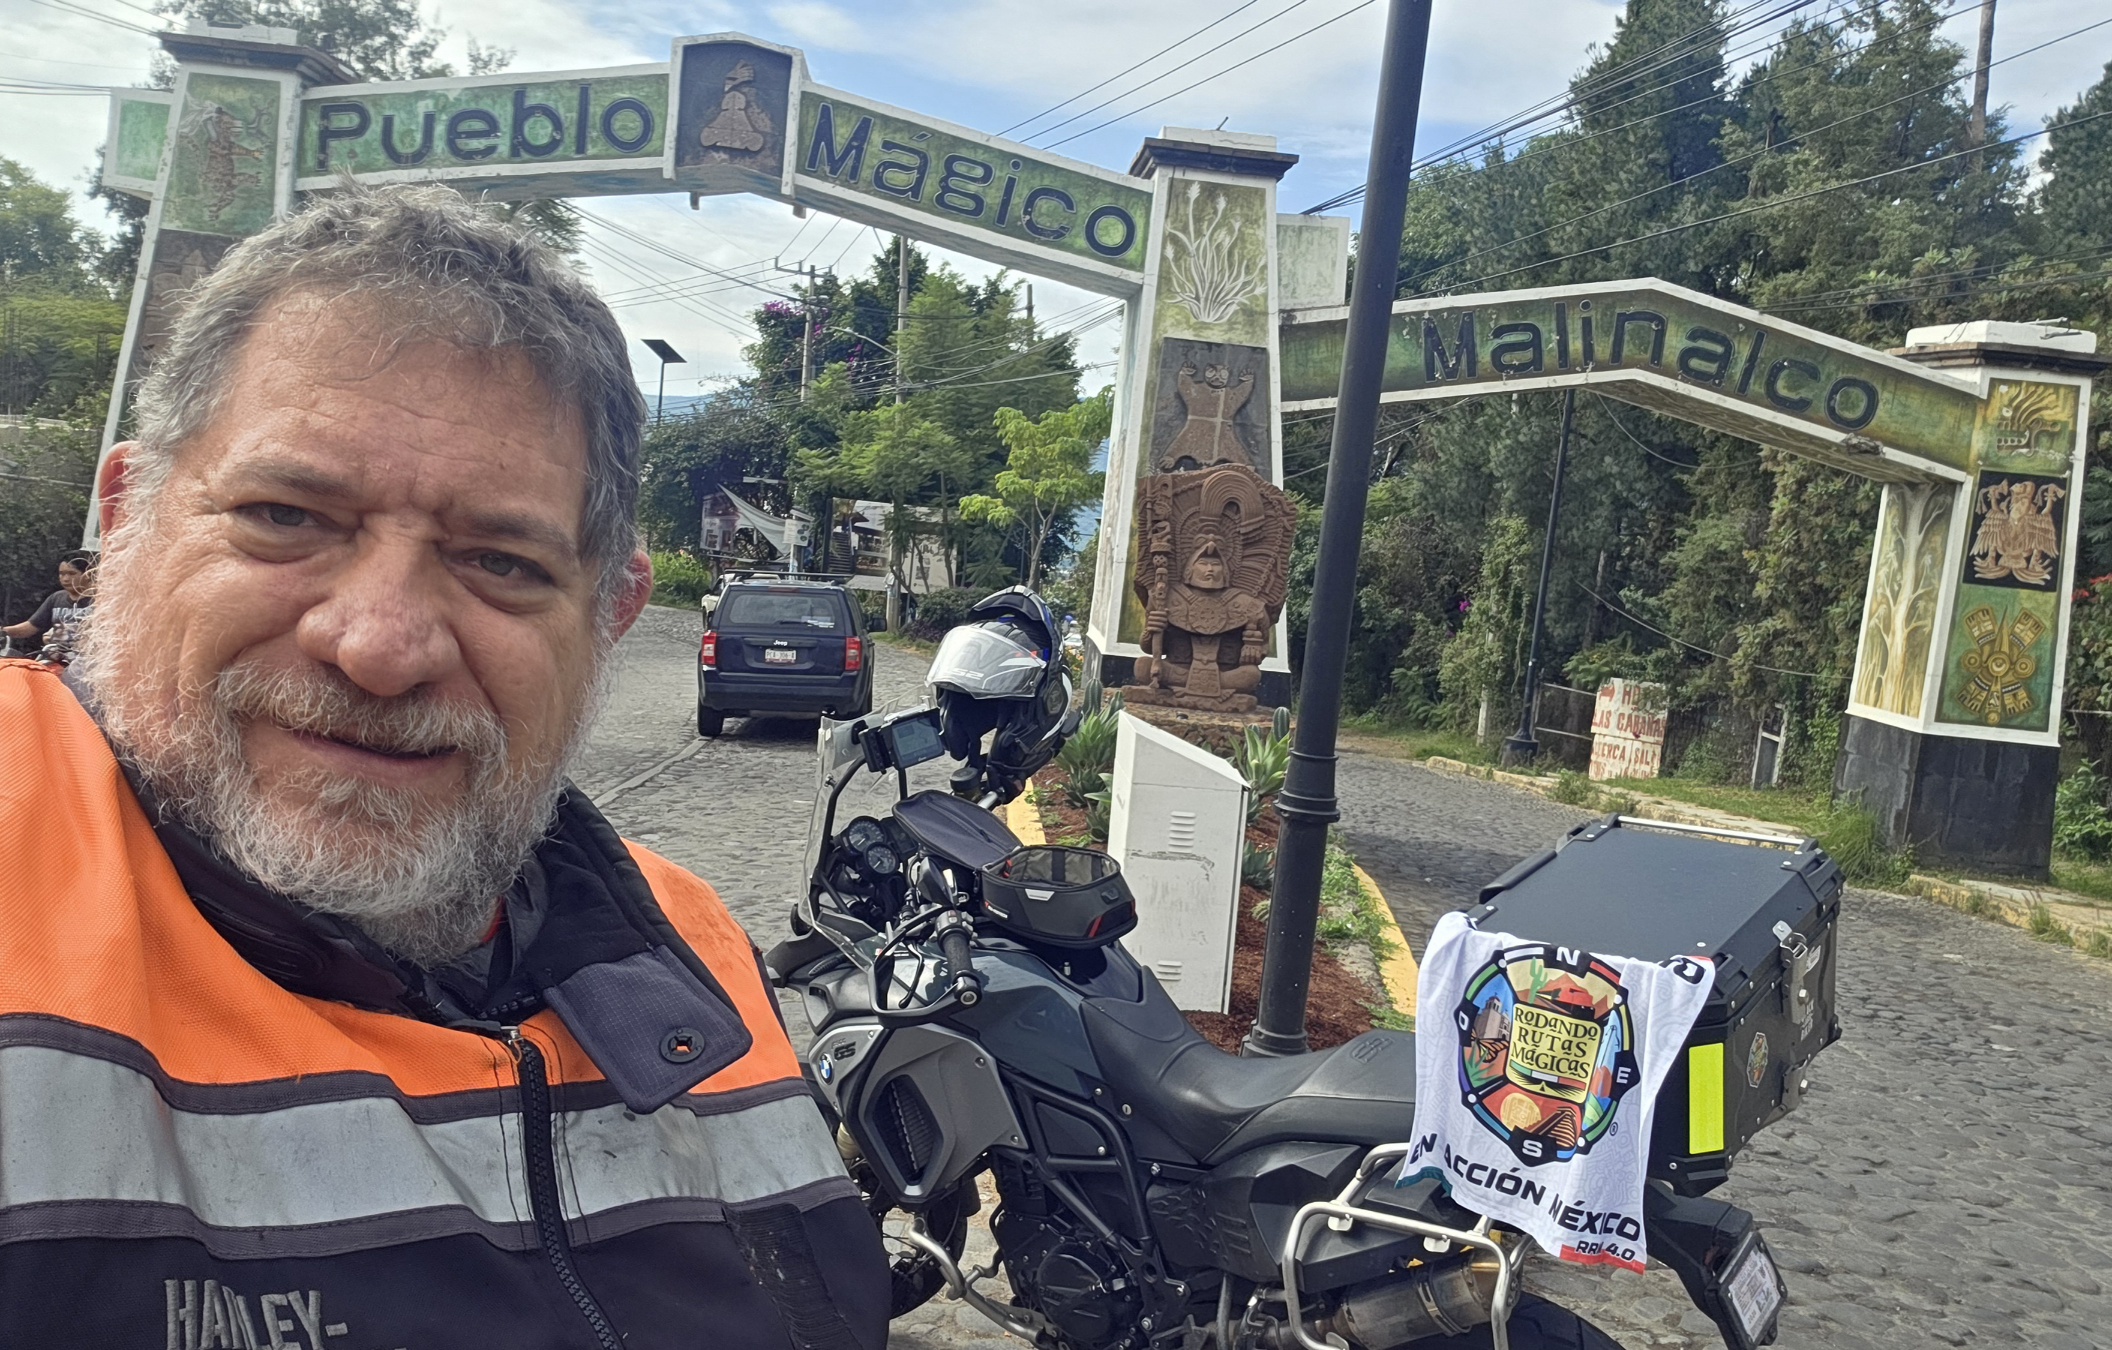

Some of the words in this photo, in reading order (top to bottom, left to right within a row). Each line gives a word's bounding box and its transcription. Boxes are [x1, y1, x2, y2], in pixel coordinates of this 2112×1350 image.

[315, 83, 654, 172] Pueblo
[806, 102, 1137, 258] Mágico
[1422, 299, 1881, 432] Malinalco
[773, 639, 788, 647] Jeep
[1592, 709, 1612, 729] LAS
[1556, 946, 1581, 966] N
[1616, 1066, 1631, 1084] E
[1522, 1139, 1543, 1158] S
[1409, 1132, 1438, 1165] EN
[1443, 1143, 1547, 1206] ACCIÓN
[1605, 1242, 1636, 1261] 4.0
